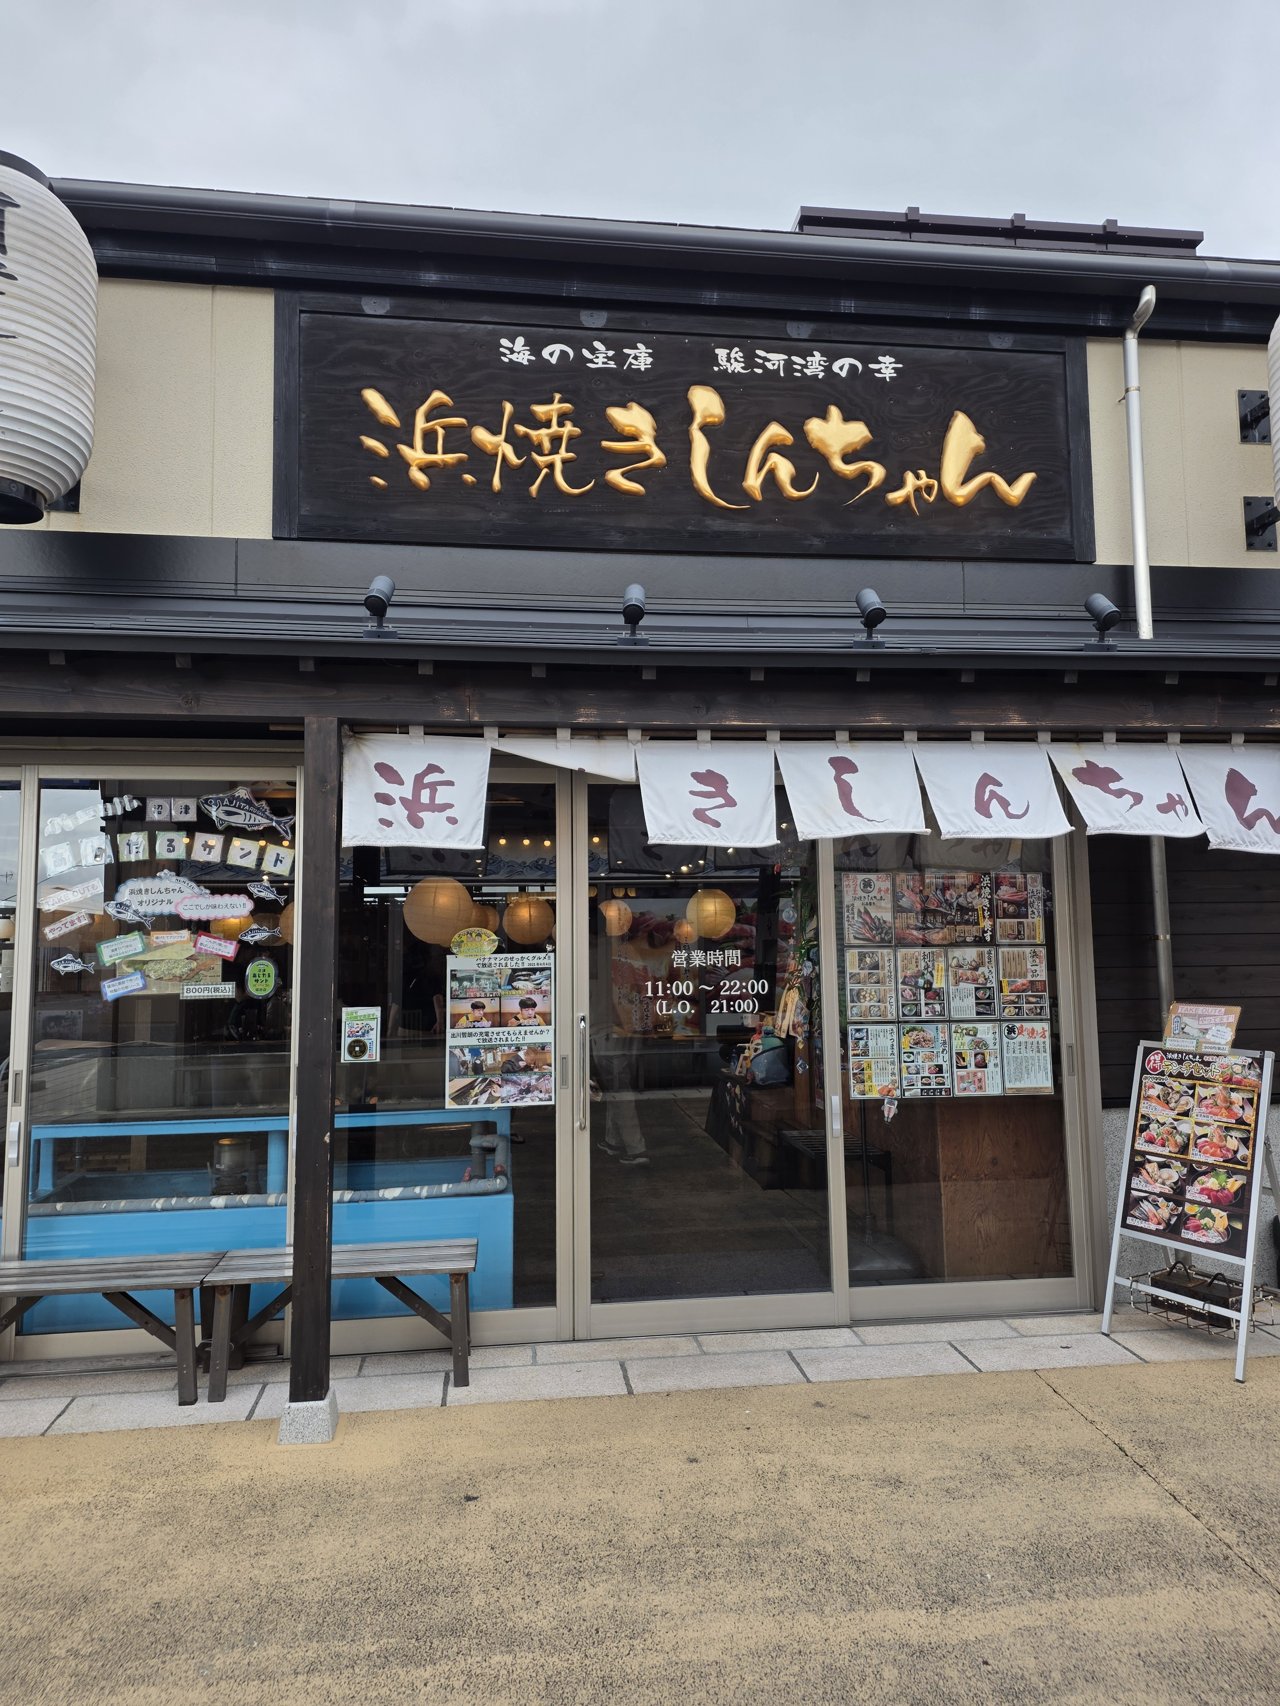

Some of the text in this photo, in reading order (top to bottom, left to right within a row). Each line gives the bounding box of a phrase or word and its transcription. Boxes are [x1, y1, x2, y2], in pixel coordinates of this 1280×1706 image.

[500, 337, 654, 371] 海の宝庫
[359, 384, 1037, 516] 浜焼きしんちゃん
[128, 886, 184, 896] 浜焼きしんちゃん
[137, 899, 173, 907] オリジナル
[671, 950, 741, 967] 営業時間
[185, 986, 231, 994] 800円(税込)
[644, 980, 694, 997] 11:00
[719, 979, 769, 996] 22:00
[656, 998, 759, 1015] (L.O. 21:00)
[1163, 1060, 1220, 1077] ランチセット
